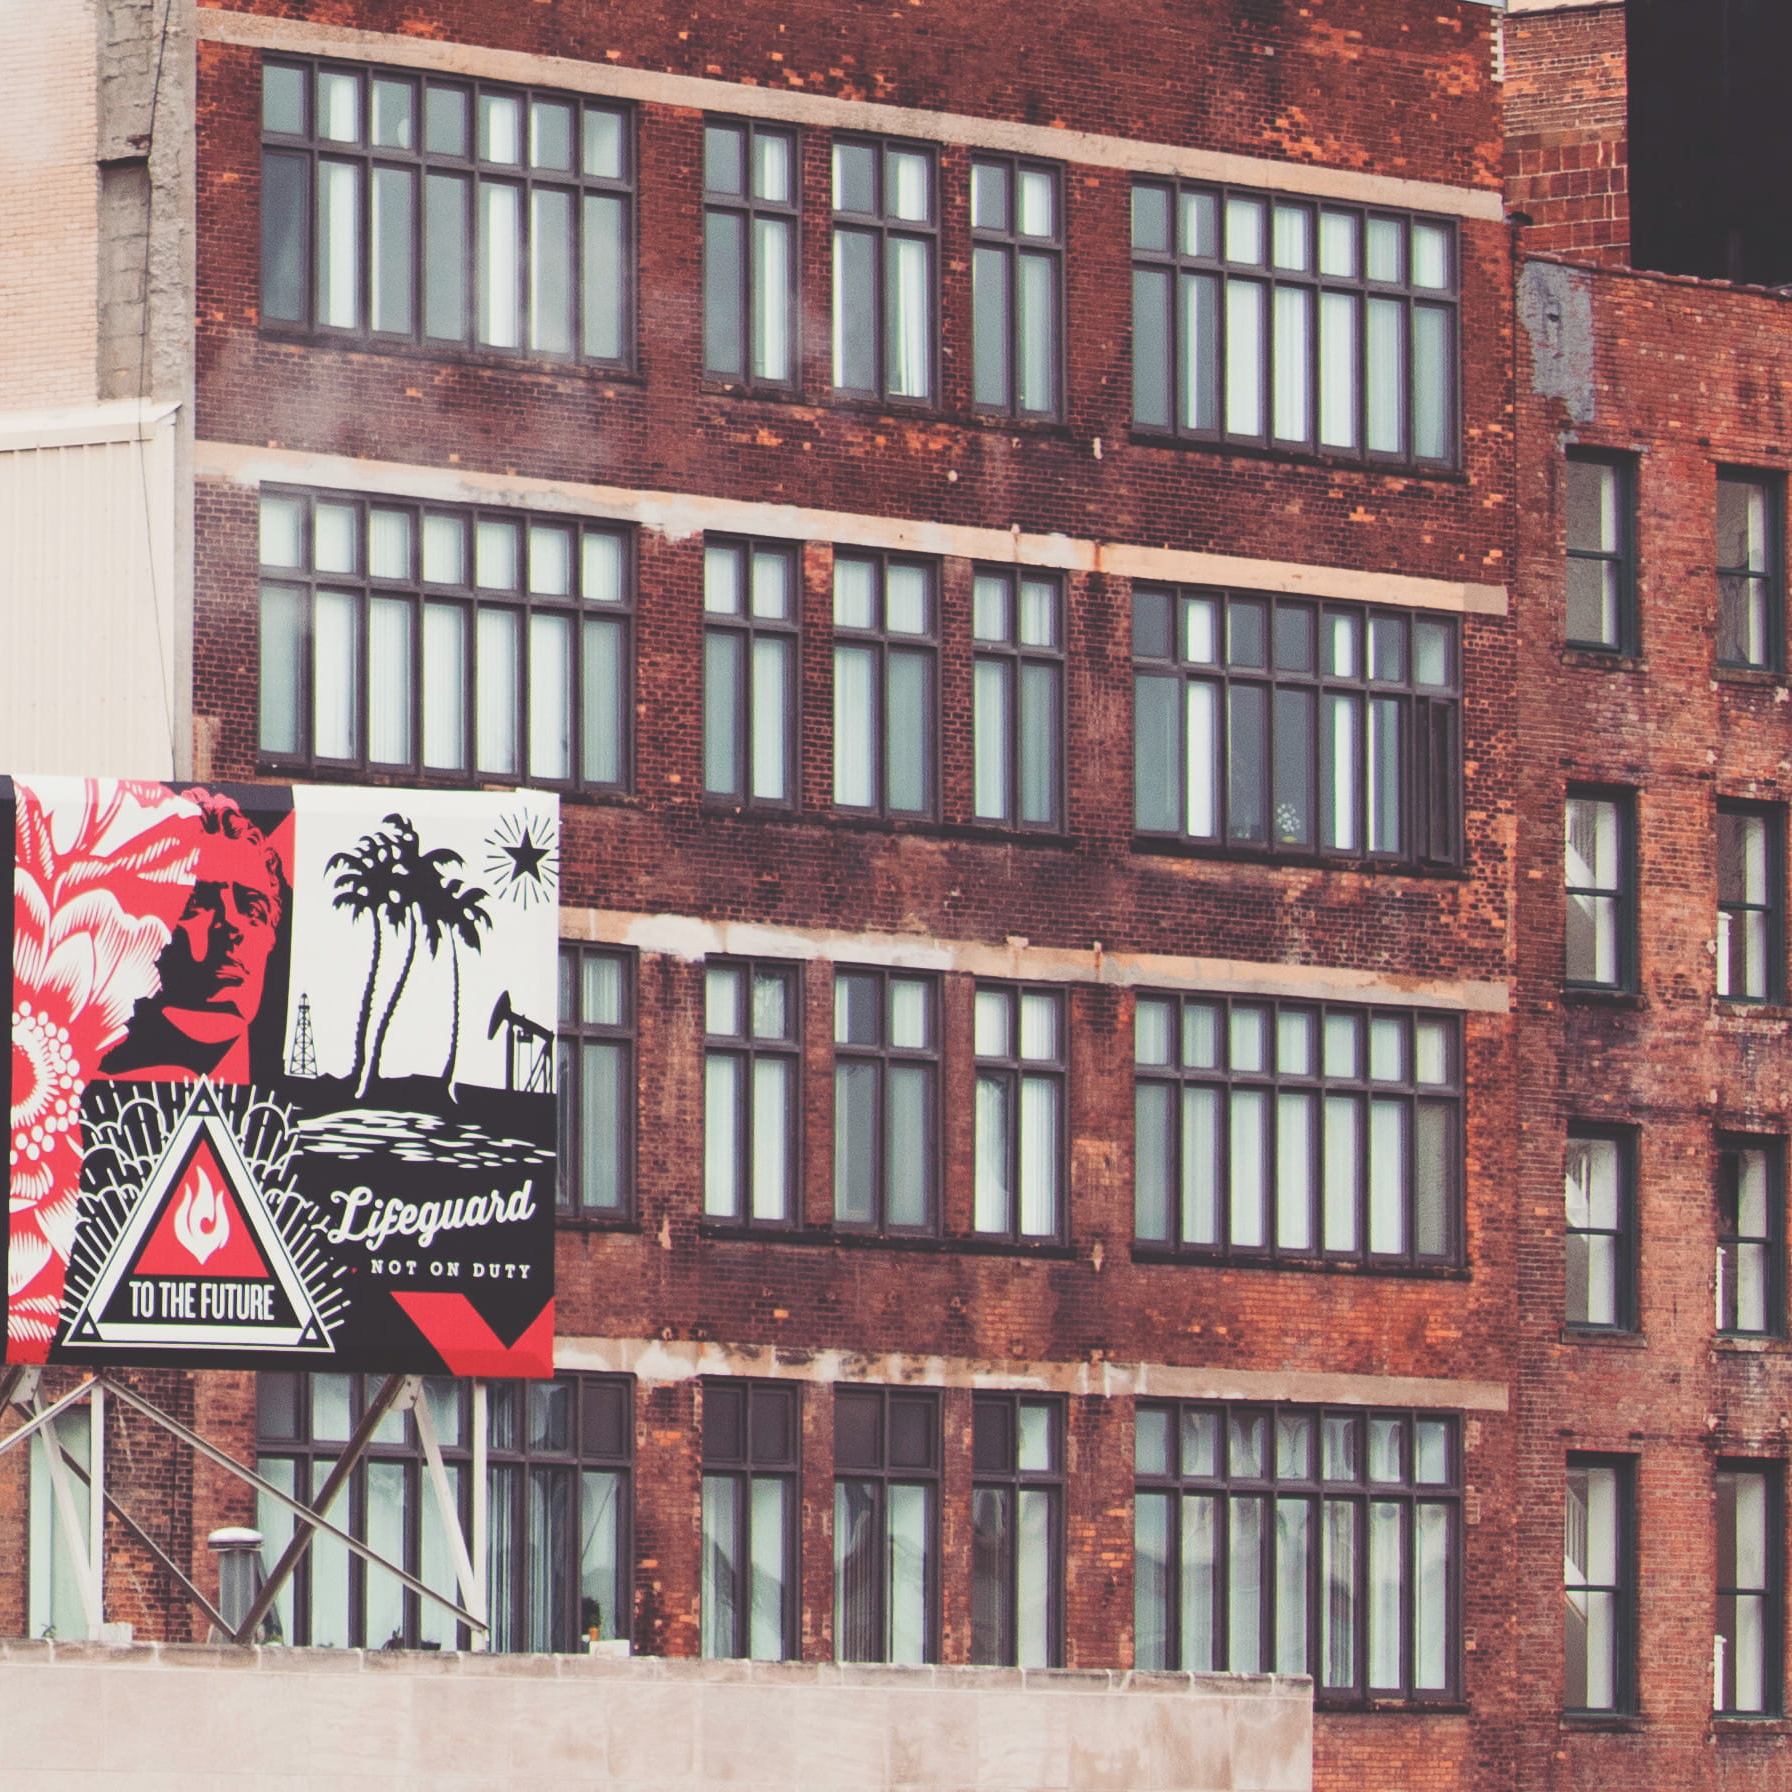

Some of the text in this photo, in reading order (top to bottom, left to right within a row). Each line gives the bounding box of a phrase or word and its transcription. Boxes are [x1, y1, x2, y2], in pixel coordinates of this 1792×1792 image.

[327, 1179, 536, 1252] Lifeguard
[370, 1259, 532, 1279] NOT ON DUTY
[128, 1280, 276, 1321] TO THE FUTURE
